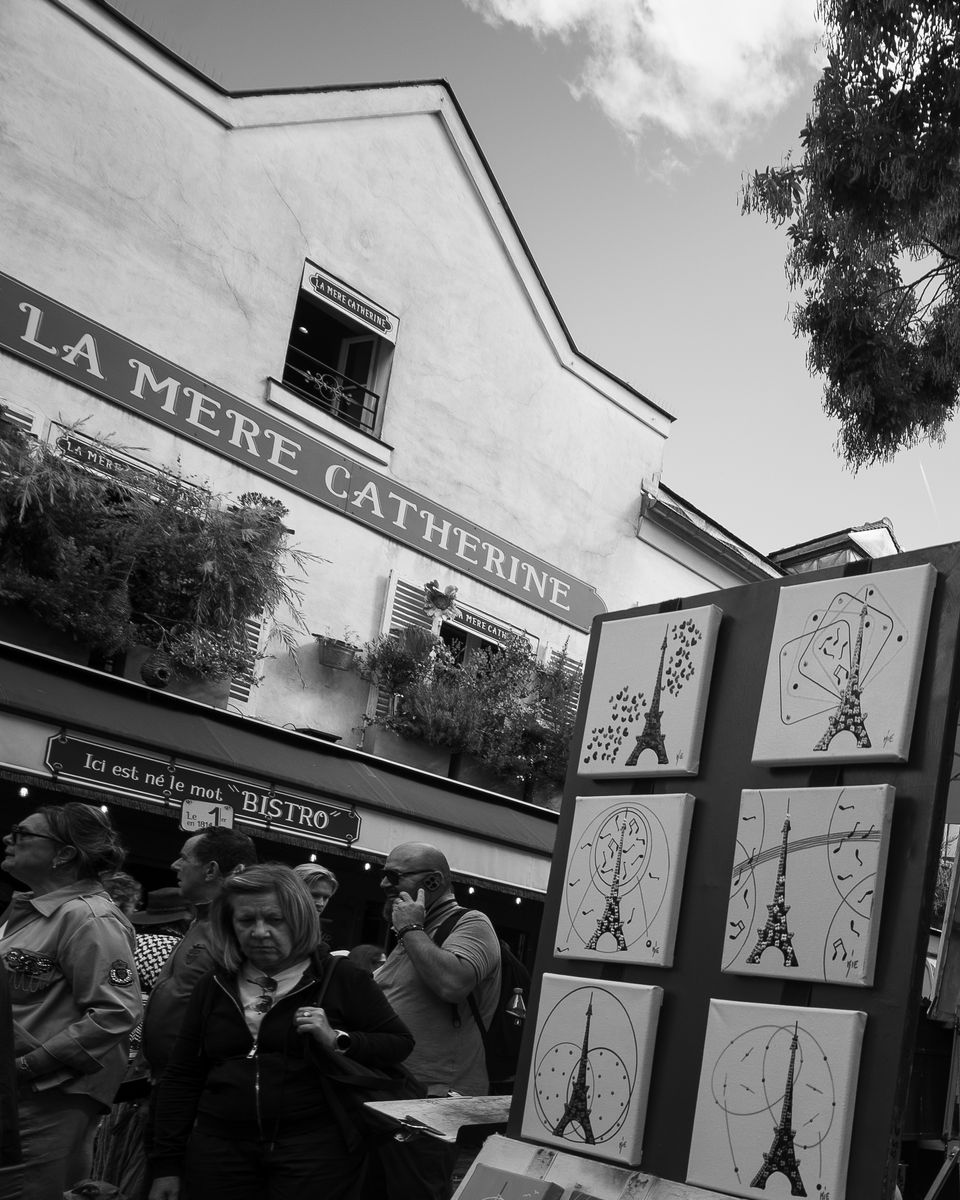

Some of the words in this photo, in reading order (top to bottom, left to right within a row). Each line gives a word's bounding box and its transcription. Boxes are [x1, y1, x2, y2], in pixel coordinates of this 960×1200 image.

[315, 277, 325, 291] LA
[327, 285, 347, 303] MERE
[347, 299, 386, 328] CATHERINE
[19, 302, 105, 380] LA
[128, 358, 302, 475] MERE
[324, 464, 571, 612] CATHERINE
[66, 441, 82, 456] LA
[465, 614, 487, 630] MERE
[83, 752, 107, 773] Ici
[112, 765, 139, 781] est
[145, 772, 165, 787] né
[169, 775, 185, 792] le
[190, 784, 223, 802] mot
[186, 811, 197, 821] Le
